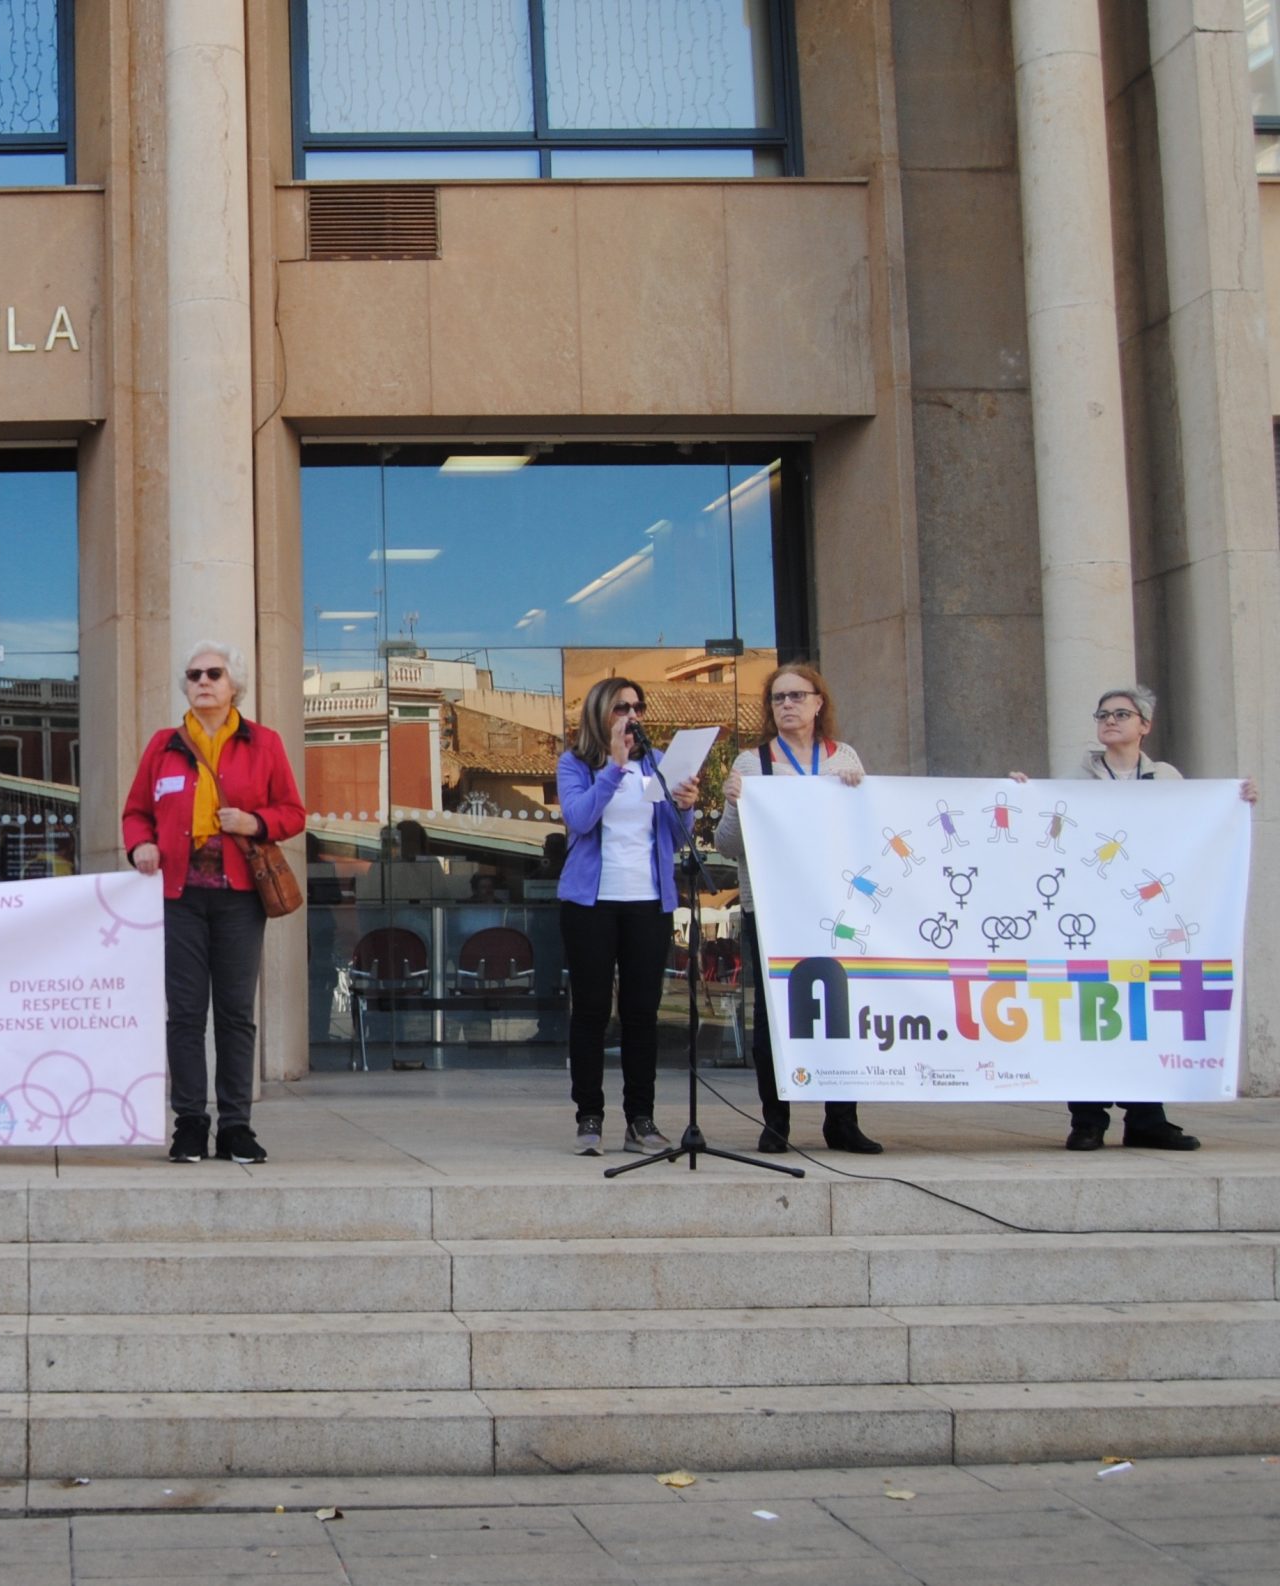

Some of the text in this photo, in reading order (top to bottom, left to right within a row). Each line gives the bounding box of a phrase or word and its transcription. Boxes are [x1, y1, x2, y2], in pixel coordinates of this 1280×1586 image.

[9, 975, 125, 993] DIVERSIÓ AMB
[22, 997, 112, 1012] RESPECTE I
[1158, 1054, 1224, 1069] Vila-re
